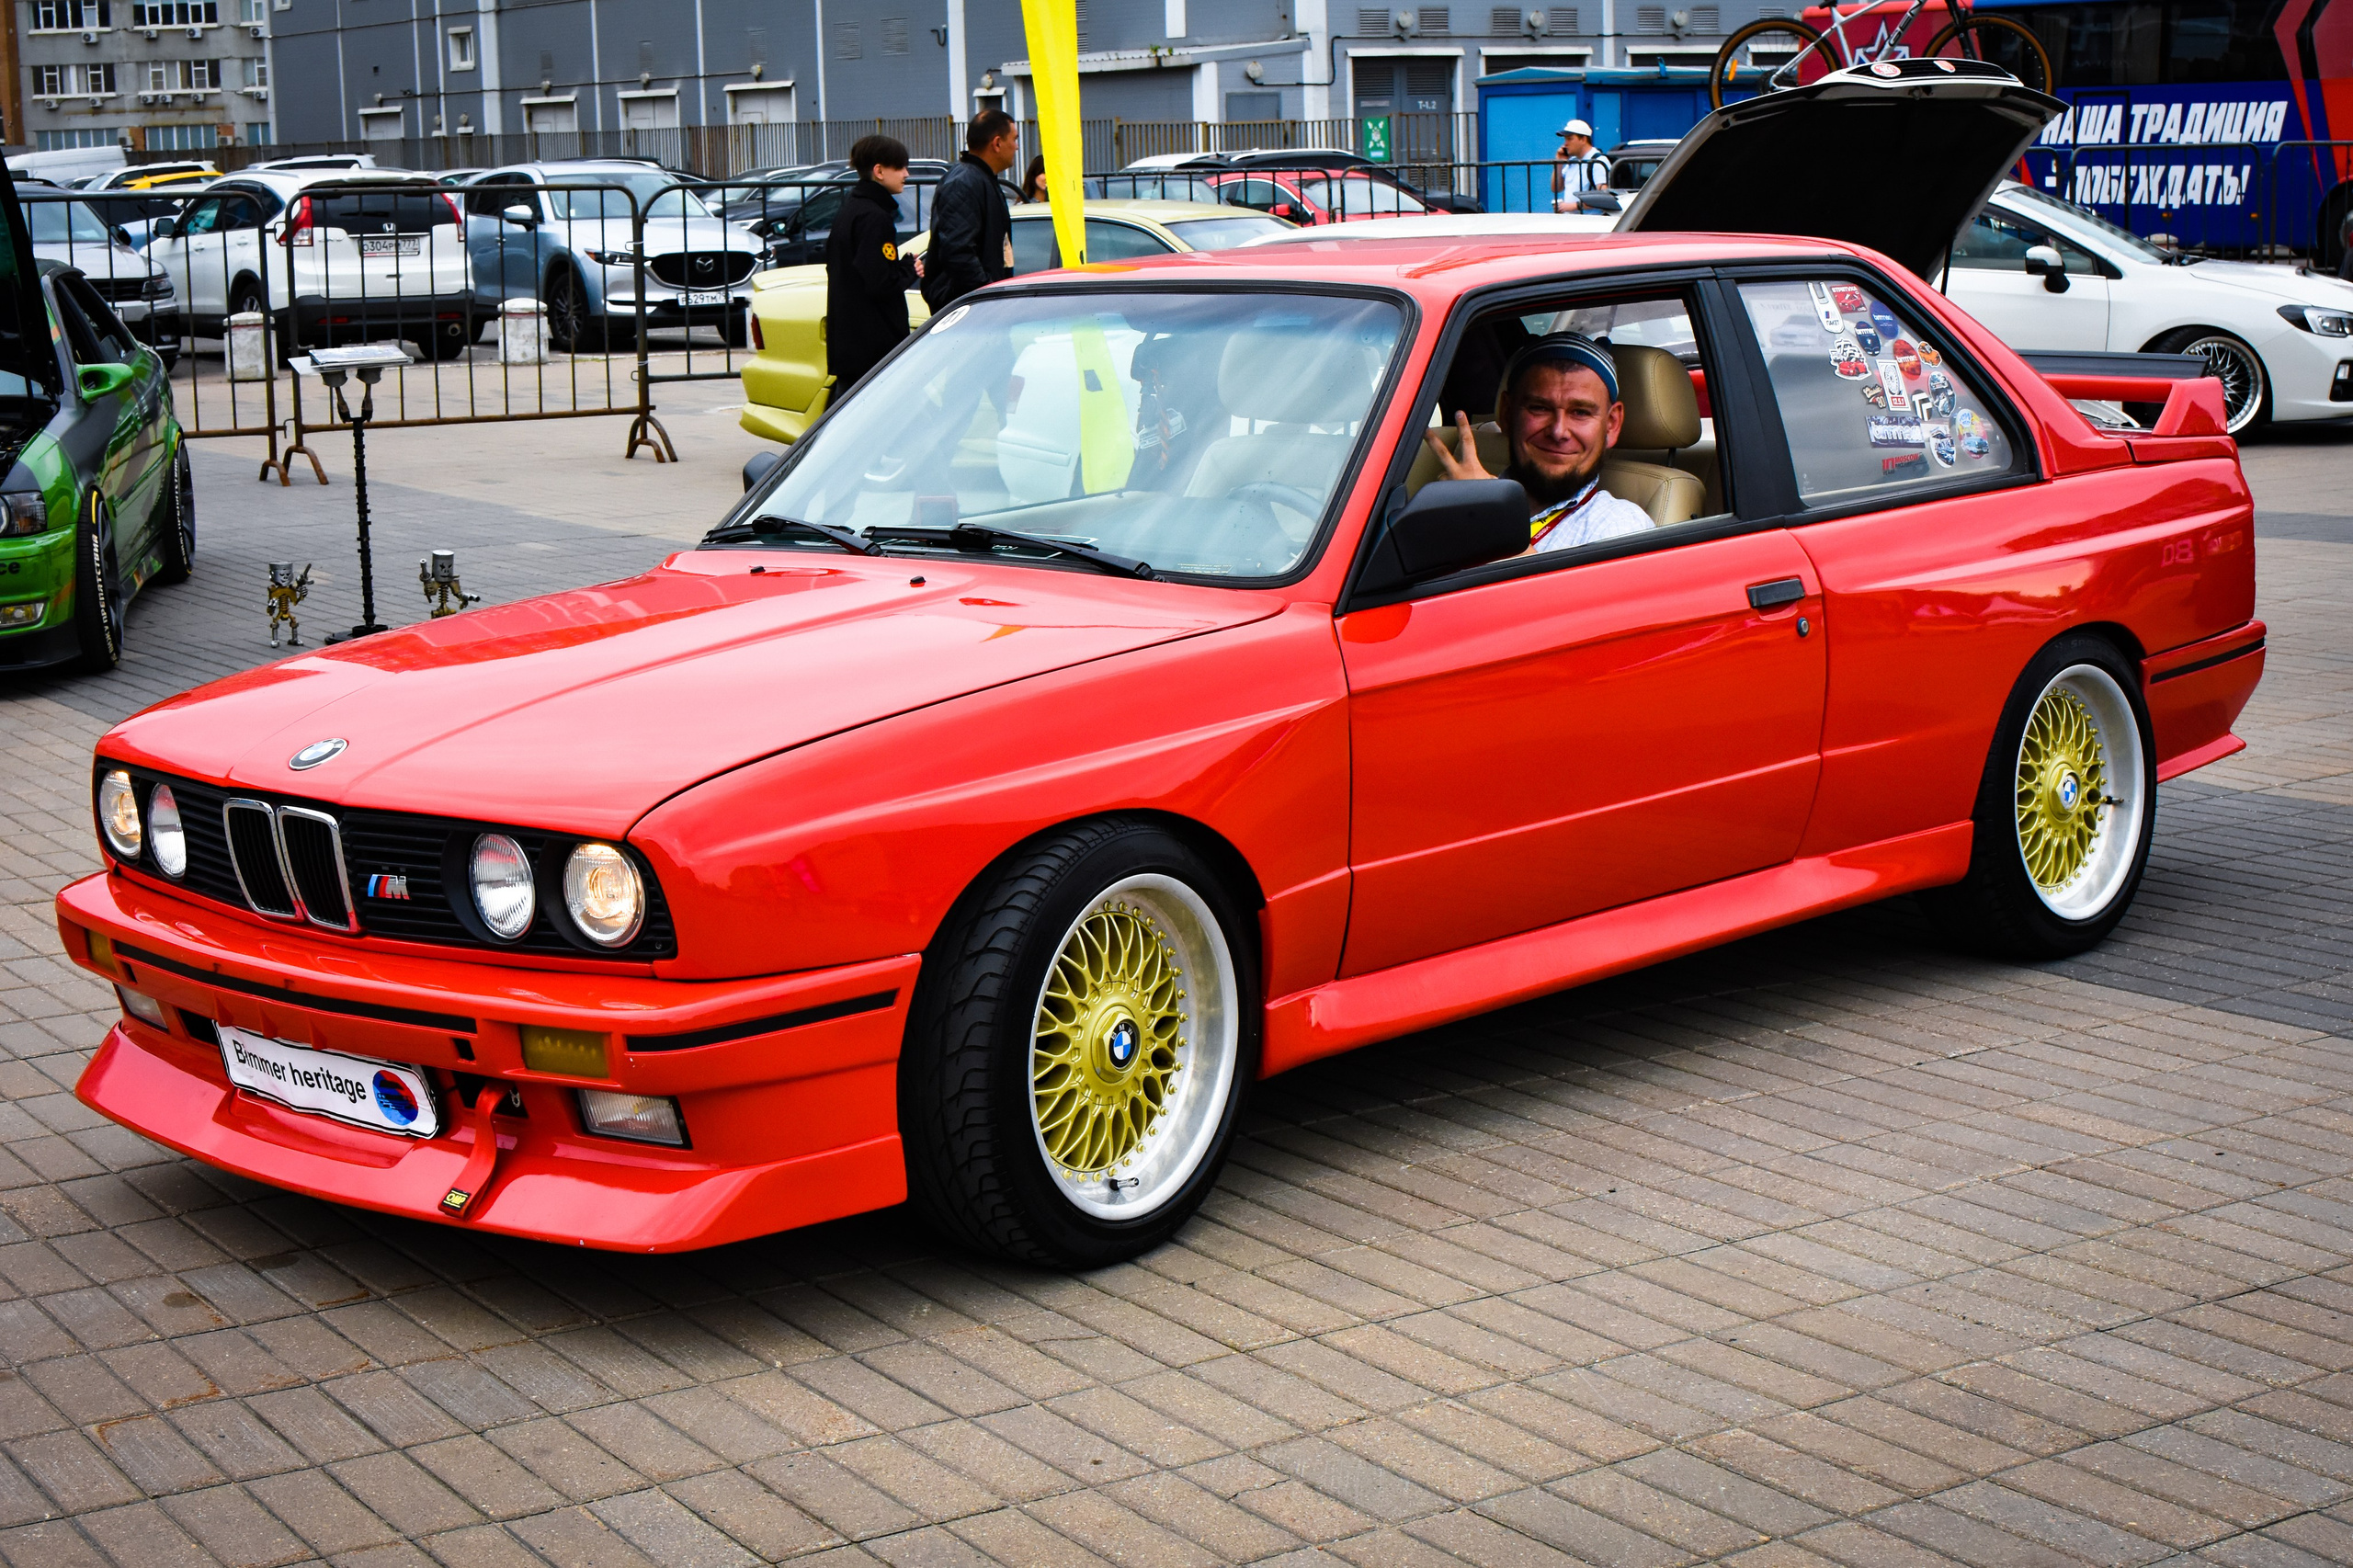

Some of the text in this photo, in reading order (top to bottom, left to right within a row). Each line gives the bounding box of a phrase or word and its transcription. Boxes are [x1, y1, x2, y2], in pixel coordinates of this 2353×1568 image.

[2040, 101, 2289, 145] НАША ТРАДИЦИЯ
[1895, 453, 1919, 462] MOSCOW
[1111, 1023, 1133, 1040] BMW
[232, 1039, 368, 1105] Bimmer heritage
[446, 1193, 467, 1205] OMP
